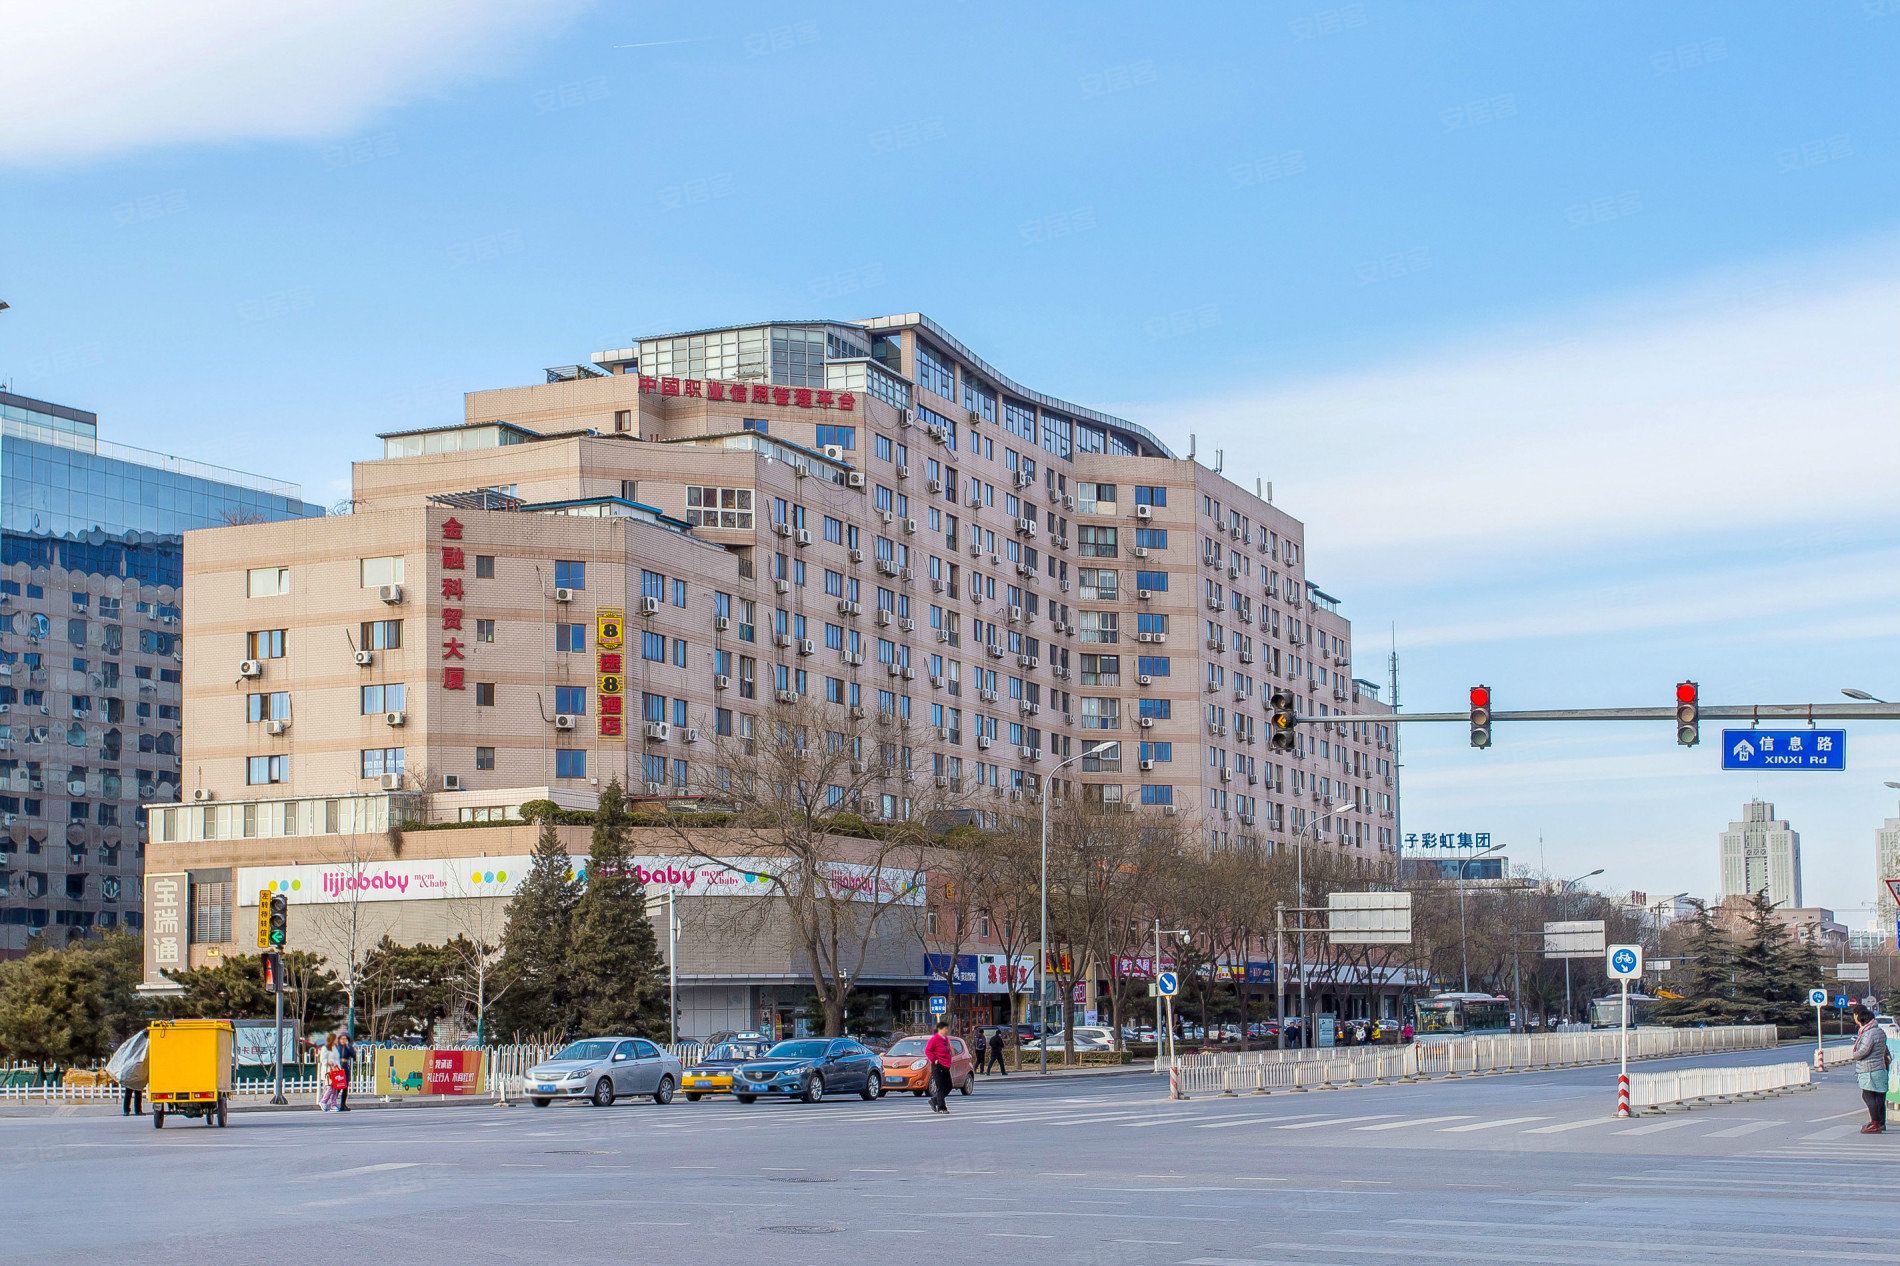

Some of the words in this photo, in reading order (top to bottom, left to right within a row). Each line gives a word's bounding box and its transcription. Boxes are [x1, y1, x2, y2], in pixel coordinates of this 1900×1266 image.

[638, 375, 856, 411] 中国职业信用管理平台
[441, 516, 465, 691] 金融科贸大厦
[1759, 736, 1833, 751] 信息路
[1765, 756, 1802, 764] XINXI
[1809, 756, 1827, 764] Rd
[1401, 832, 1491, 849] 子彩虹集团
[323, 870, 409, 898] lijiababy
[153, 878, 179, 963] 宝瑞通
[260, 892, 269, 946] 左转待转信号
